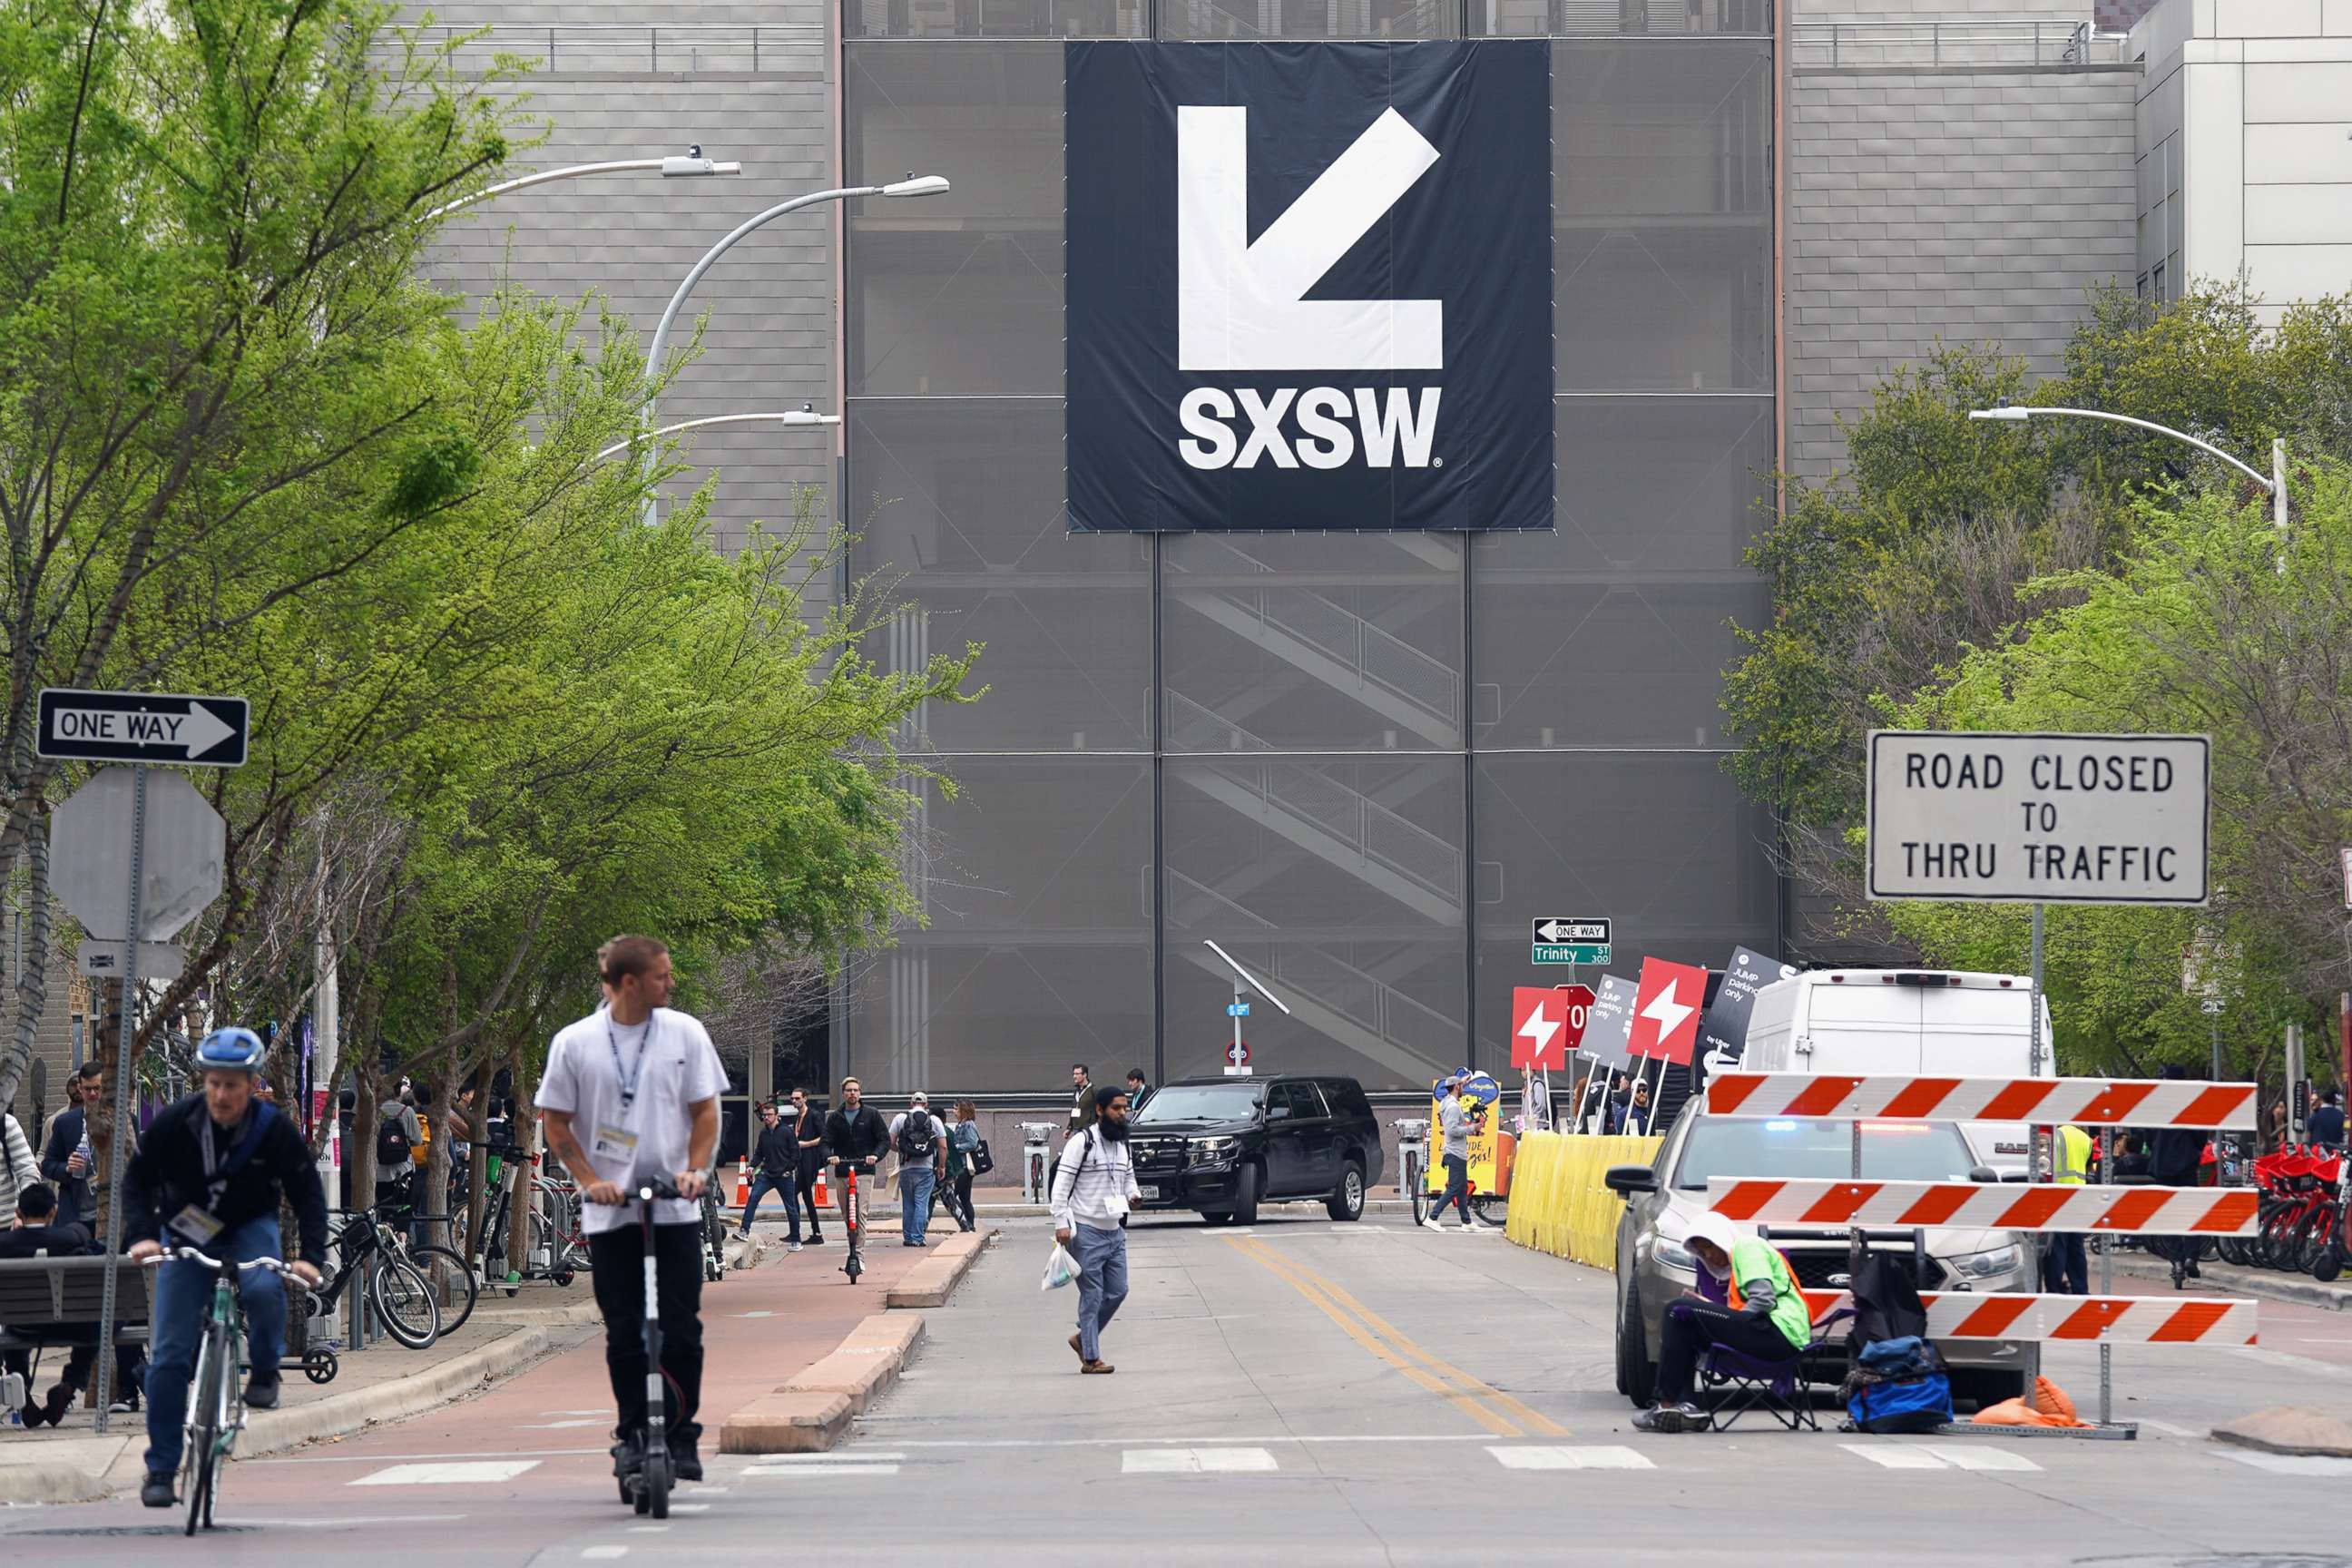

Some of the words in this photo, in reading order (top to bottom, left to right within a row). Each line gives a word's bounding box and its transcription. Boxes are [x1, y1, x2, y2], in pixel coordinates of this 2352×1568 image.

[1179, 387, 1442, 470] SXSW
[61, 712, 115, 738] ONE
[127, 715, 183, 740] WAY
[1906, 753, 2004, 789] ROAD
[2031, 755, 2173, 792] CLOSED
[2021, 802, 2057, 832] TO
[1901, 843, 1995, 878] THRU
[2024, 845, 2176, 882] TRAFFIC
[1555, 926, 1576, 936] ONE
[1580, 926, 1602, 936] WAY
[1534, 947, 1577, 964] Trinity
[1597, 946, 1609, 955] ST
[1592, 955, 1609, 963] 300
[1733, 967, 1759, 982] JUMP
[1601, 992, 1622, 1002] JUMP
[1725, 988, 1744, 1002] only
[1595, 1010, 1610, 1020] only
[1597, 1001, 1622, 1014] parking
